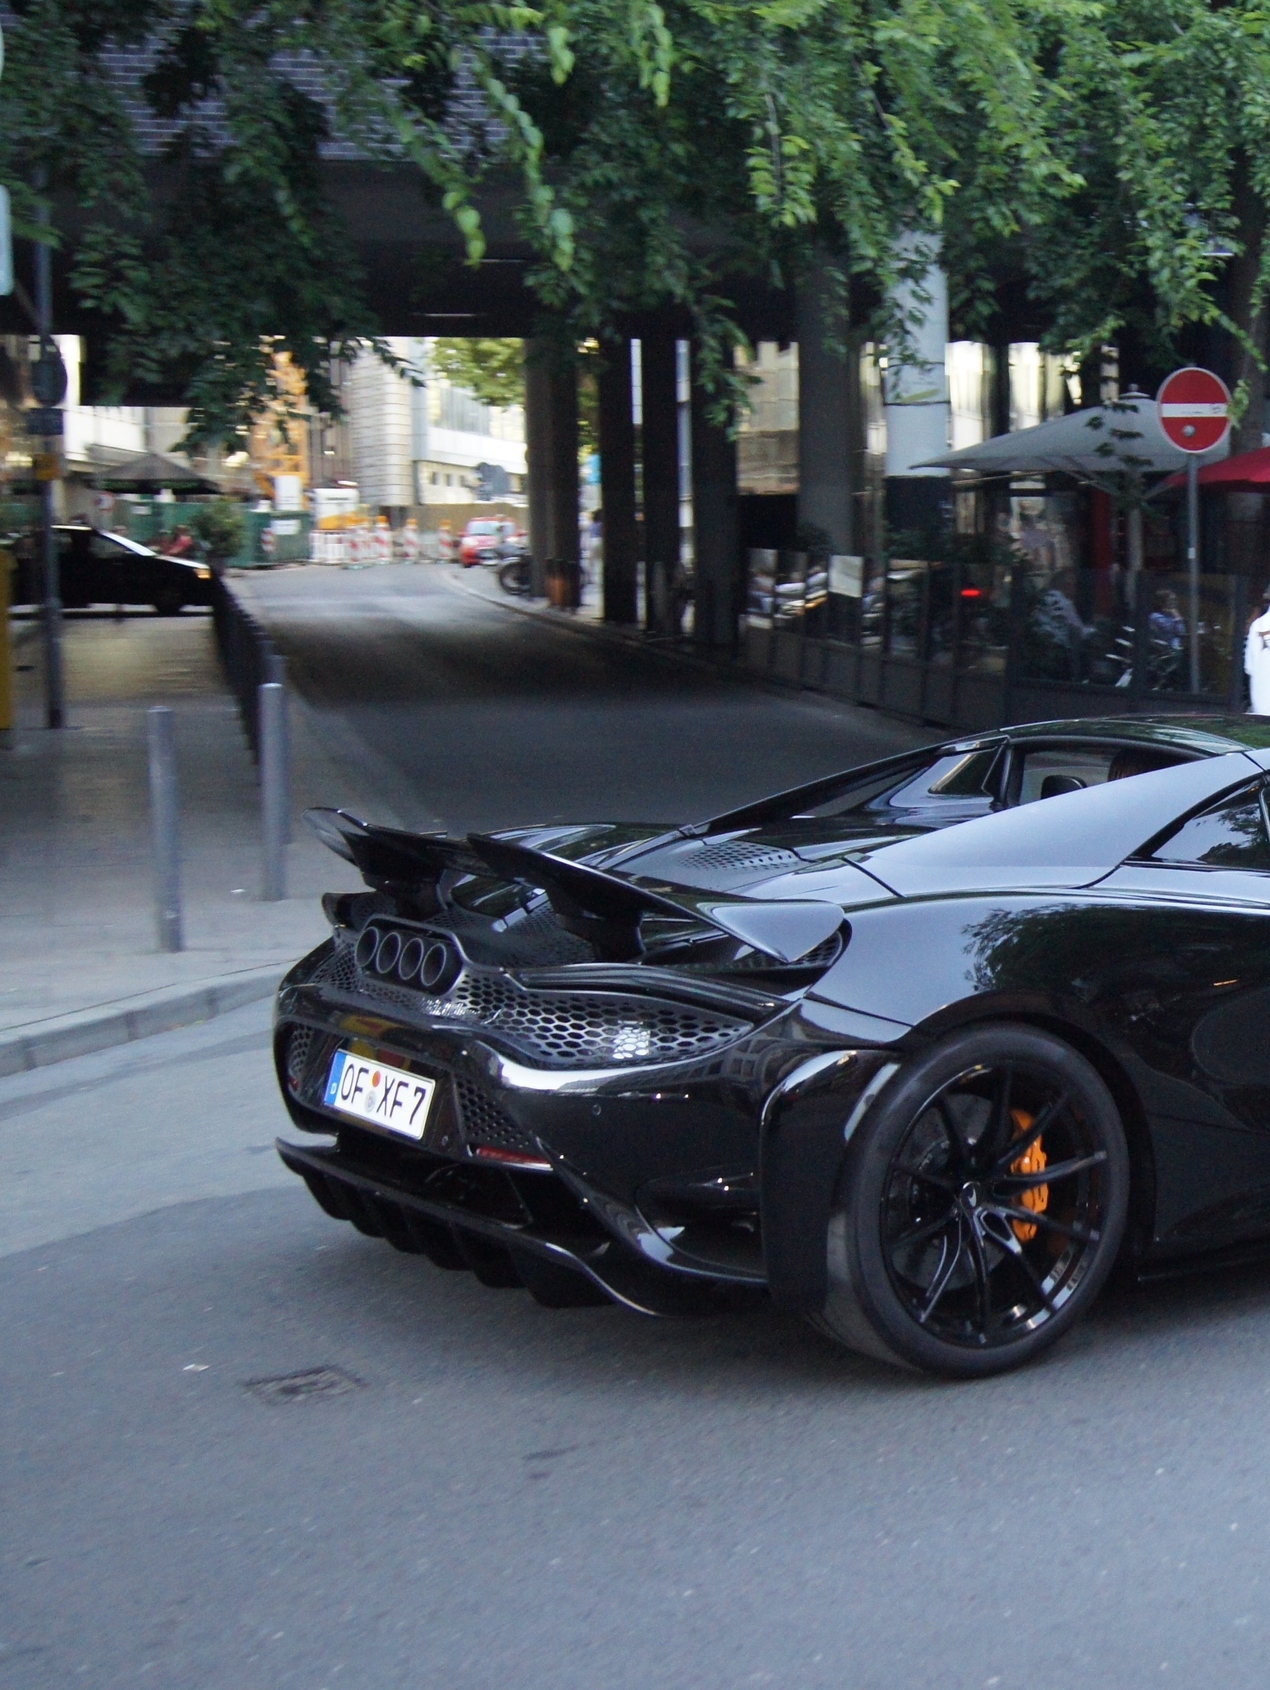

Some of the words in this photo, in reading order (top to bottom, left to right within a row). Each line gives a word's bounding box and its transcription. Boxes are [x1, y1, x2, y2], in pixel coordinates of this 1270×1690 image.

[341, 1063, 370, 1103] OF
[376, 1075, 410, 1118] XF
[409, 1086, 427, 1126] 7
